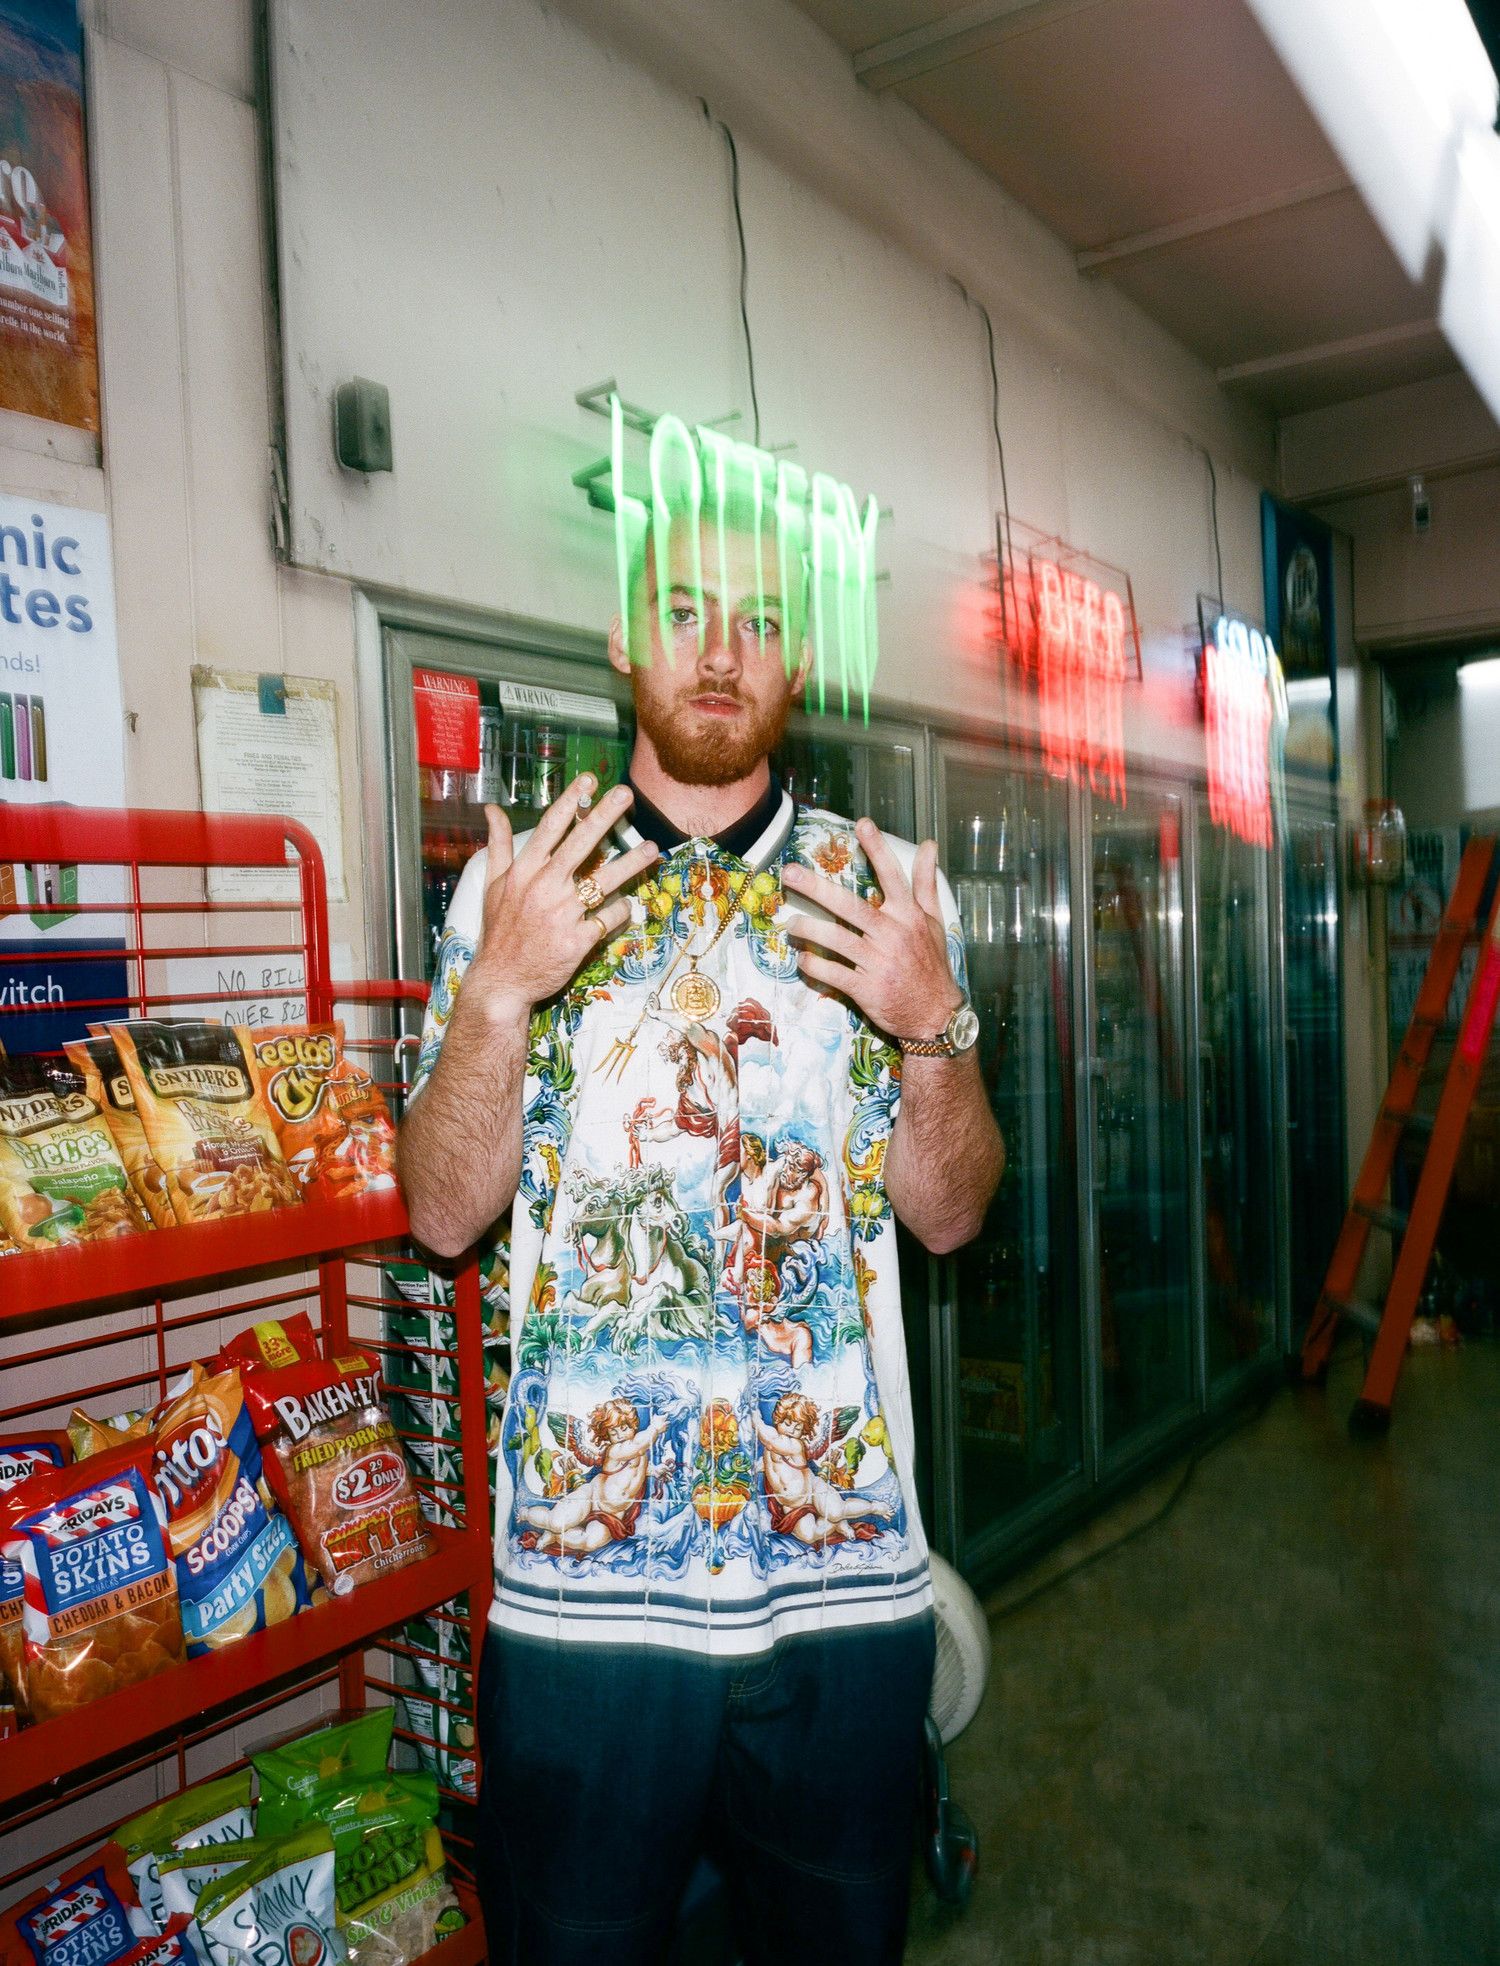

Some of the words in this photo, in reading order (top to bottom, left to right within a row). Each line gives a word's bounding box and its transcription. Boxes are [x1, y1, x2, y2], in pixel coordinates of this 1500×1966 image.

[44, 312, 70, 329] selling
[422, 673, 470, 694] WARNING:
[217, 968, 246, 1000] NO
[154, 1067, 239, 1090] SNYDER'S
[293, 1441, 336, 1473] FRIED
[334, 1424, 379, 1451] PORK
[371, 1467, 402, 1488] ONLY
[50, 1524, 145, 1574] POTATO
[186, 1477, 260, 1576] SCOOPS!
[53, 1541, 151, 1595] SKINS
[197, 1562, 257, 1629] Party
[251, 1520, 287, 1573] Size!
[373, 1542, 428, 1570] Chicharrones
[52, 1599, 111, 1634] CHEDDAR
[115, 1594, 125, 1610] &
[126, 1573, 171, 1606] BACON
[233, 1868, 314, 1949] SKINNY
